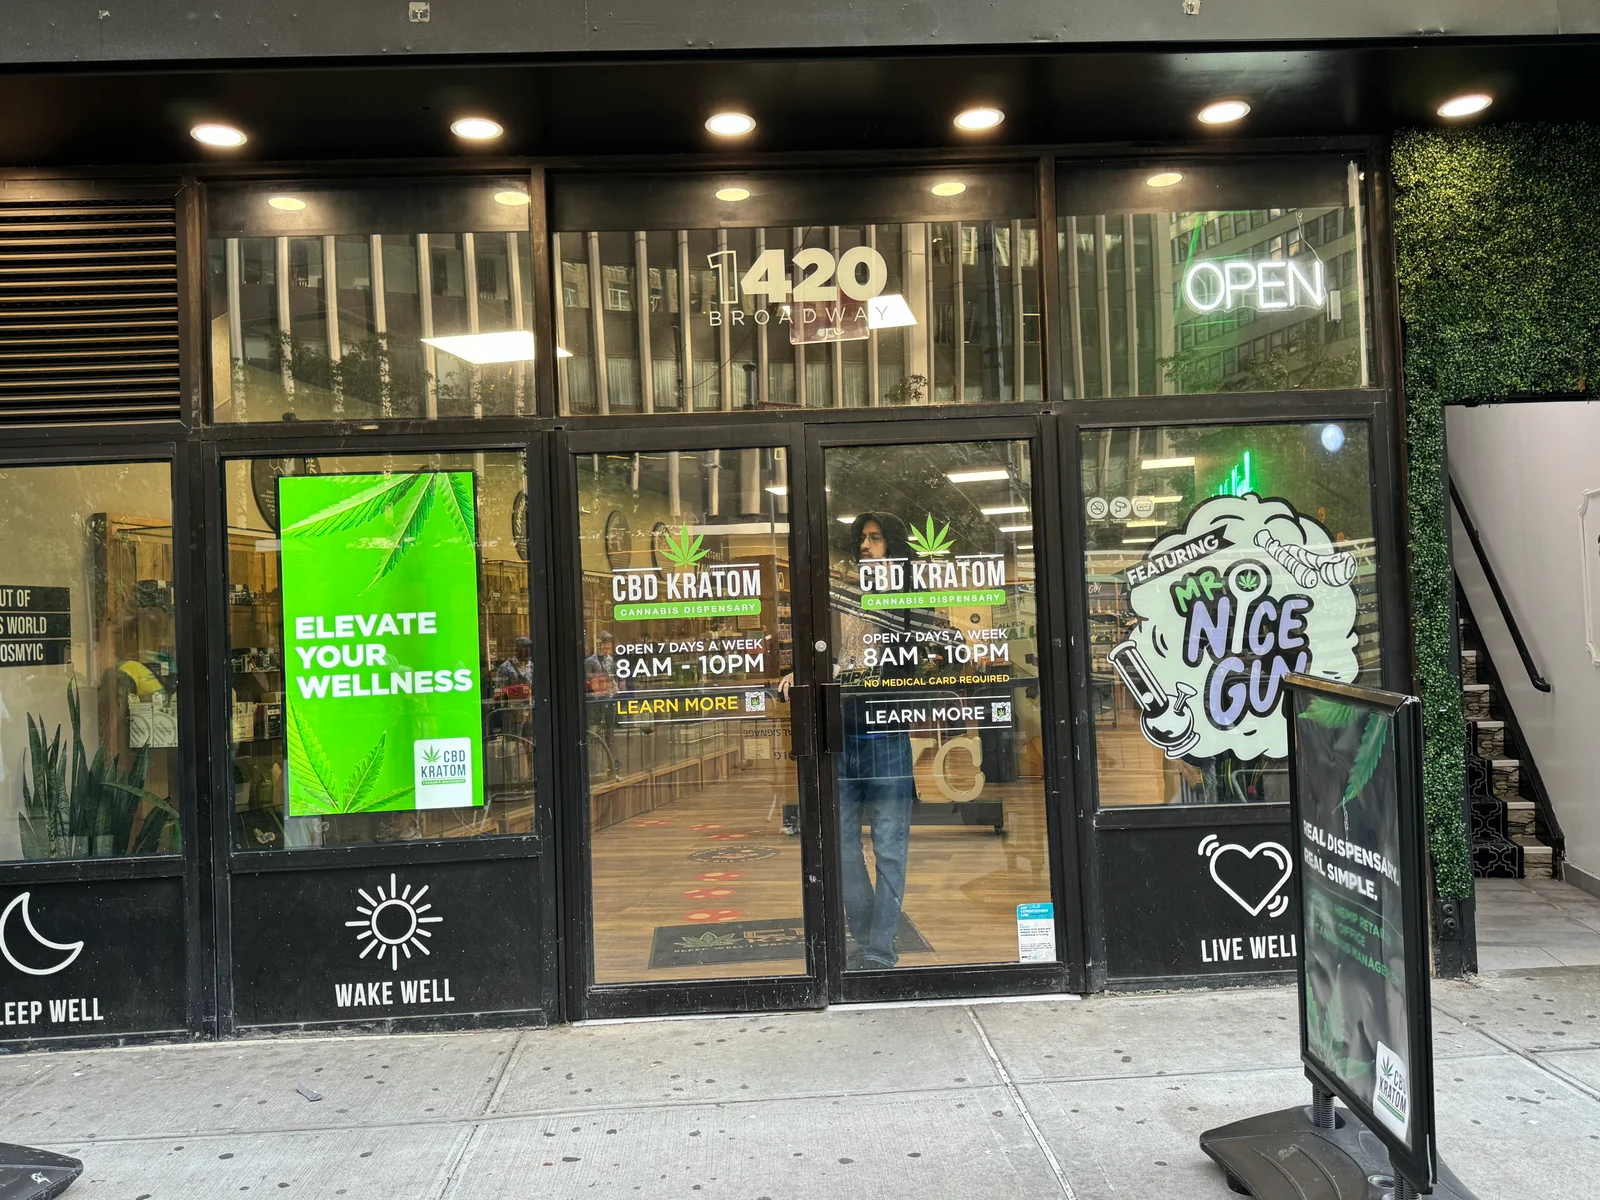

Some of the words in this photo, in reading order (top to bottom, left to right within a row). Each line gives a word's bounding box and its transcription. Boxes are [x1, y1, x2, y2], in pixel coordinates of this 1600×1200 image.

[707, 246, 888, 304] 1420
[1185, 262, 1323, 311] OPEN
[709, 305, 889, 327] BROADWAY
[1126, 534, 1220, 587] FEATURING
[612, 573, 658, 602] CBD
[666, 569, 761, 600] KRATOM
[859, 564, 904, 592] CBD
[912, 560, 1006, 590] KRATOM
[16, 589, 31, 608] OF
[867, 596, 924, 606] CANNABIS
[929, 593, 1000, 604] DISPENSARY
[1173, 570, 1223, 613] MR
[620, 606, 679, 616] CANNABIS
[684, 603, 756, 614] DISPENSARY
[1188, 564, 1309, 663] NICE
[6, 616, 47, 635] WORLD
[295, 611, 437, 640] ELEVATE
[862, 633, 900, 645] OPEN
[904, 632, 911, 643] 7
[915, 630, 950, 642] DAYS
[954, 630, 963, 641] A
[968, 628, 1008, 640] WEEK
[294, 643, 387, 669] YOUR
[615, 643, 653, 655] OPEN
[657, 642, 664, 654] 7
[669, 641, 704, 653] DAYS
[708, 641, 718, 651] A
[721, 638, 763, 651] WEEK
[863, 646, 918, 667] 8AM
[944, 642, 1009, 664] 10PM
[615, 656, 672, 679] 8AM
[698, 653, 764, 675] 10PM
[296, 668, 473, 700] WELLNESS
[864, 679, 879, 688] NO
[882, 677, 926, 687] MEDICAL
[928, 676, 957, 686] CARD
[959, 674, 1010, 685] REQUIRED
[617, 698, 678, 715] LEARN
[685, 695, 739, 712] MORE
[865, 708, 926, 725] LEARN
[932, 706, 985, 722] MORE
[443, 749, 466, 763] CBD
[420, 763, 467, 779] KRATOM
[1302, 819, 1327, 848] REAL
[1326, 832, 1400, 887] DISPENSARY.
[1303, 847, 1326, 877] REAL
[1327, 862, 1378, 901] SIMPLE.
[1201, 937, 1244, 963] LIVE
[335, 981, 393, 1008] WAKE
[400, 978, 456, 1005] WELL
[48, 997, 105, 1023] WELL
[1379, 1075, 1407, 1115] KRATOM
